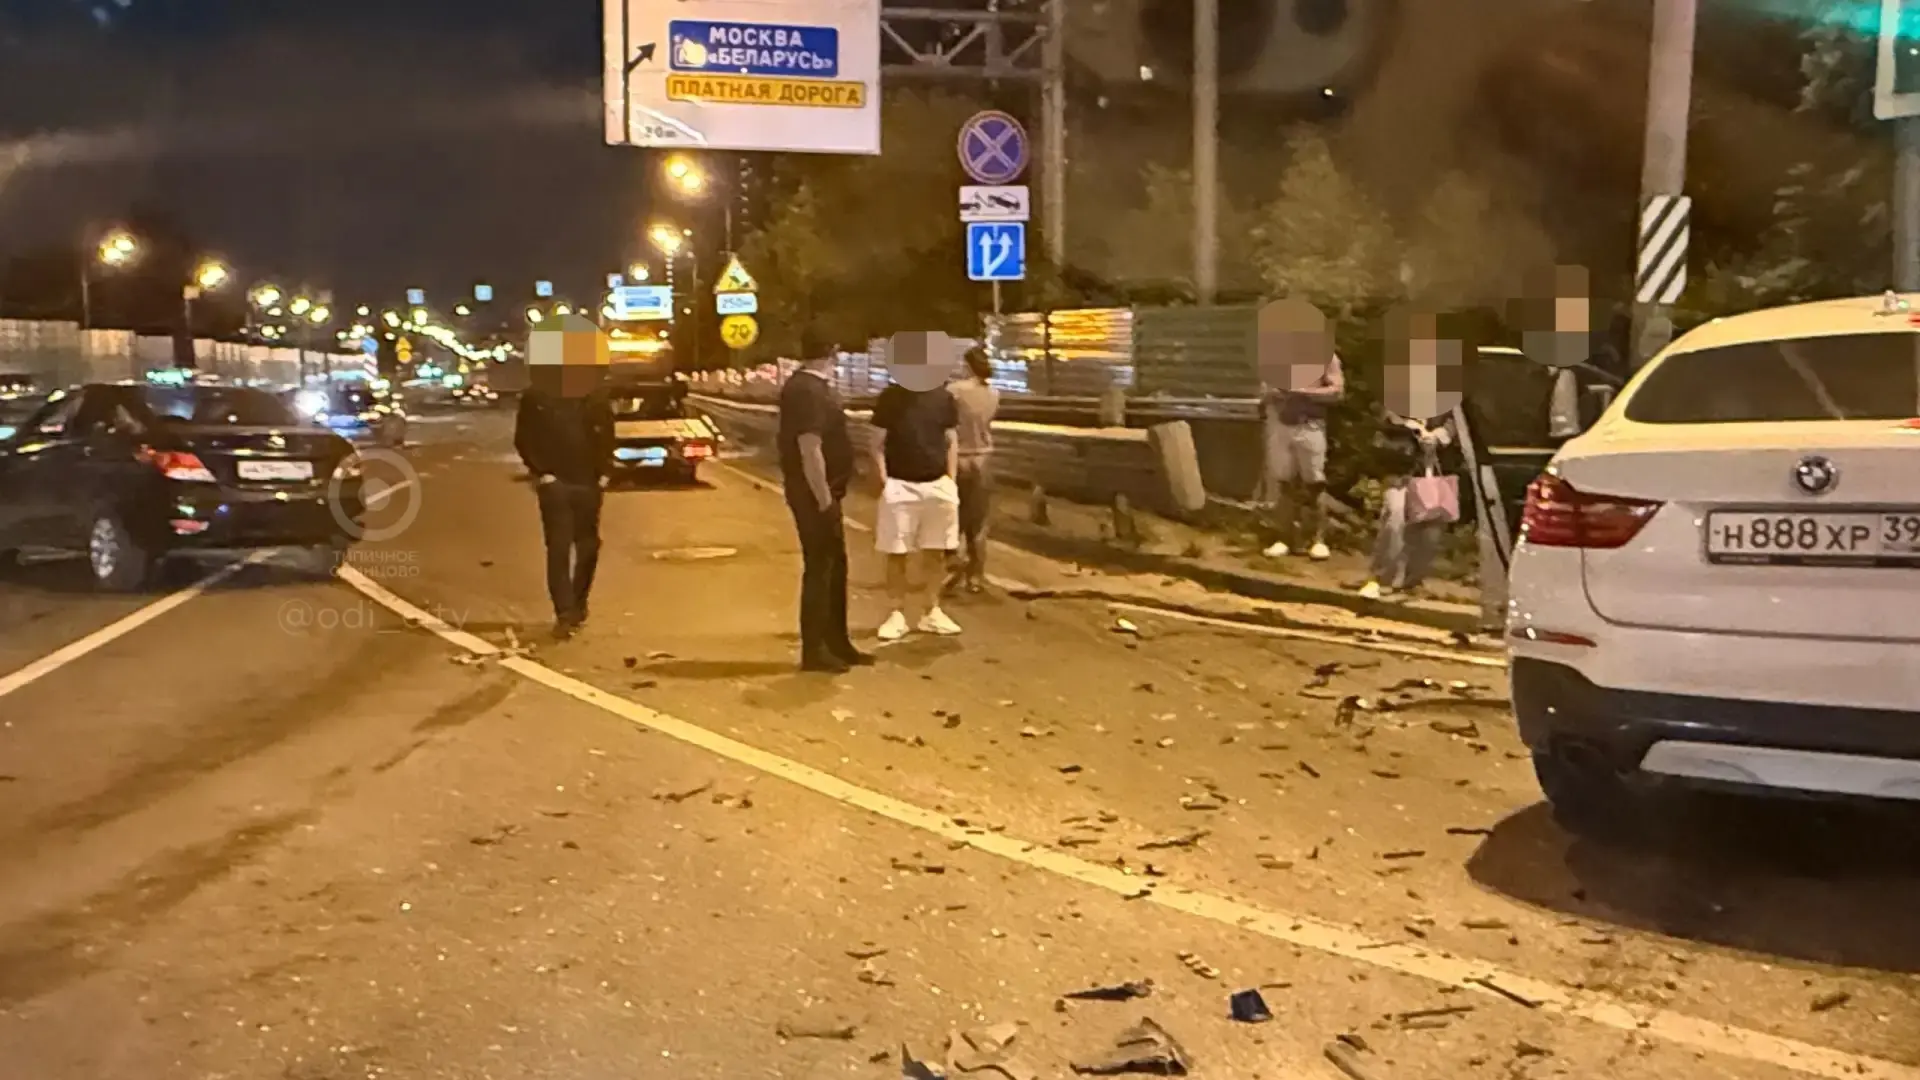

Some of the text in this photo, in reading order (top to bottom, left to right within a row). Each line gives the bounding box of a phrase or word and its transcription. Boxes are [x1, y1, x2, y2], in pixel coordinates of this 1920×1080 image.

[709, 26, 803, 48] МОСКВА
[708, 47, 832, 70] «БЕЛАРУСЬ»
[672, 80, 861, 105] ПЛАТНАЯ ДОРОГА
[729, 324, 752, 340] 70
[1724, 518, 1870, 550] Н888ХР
